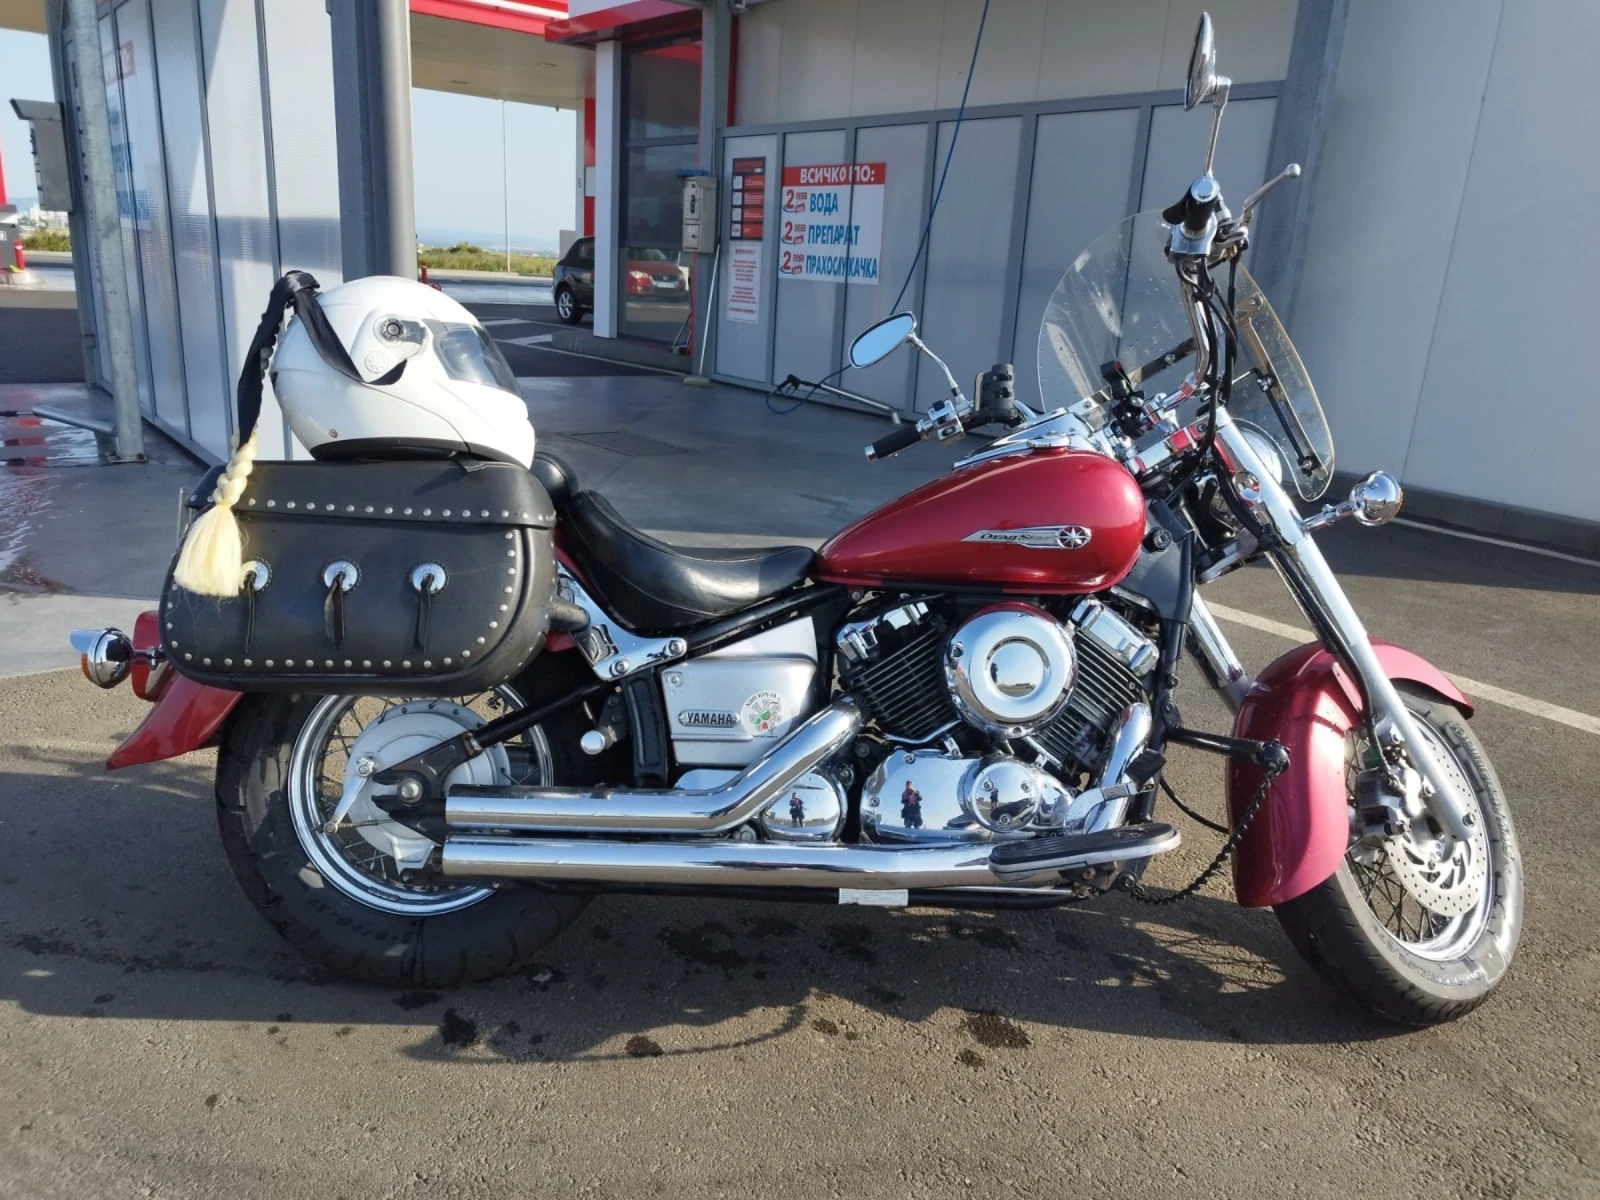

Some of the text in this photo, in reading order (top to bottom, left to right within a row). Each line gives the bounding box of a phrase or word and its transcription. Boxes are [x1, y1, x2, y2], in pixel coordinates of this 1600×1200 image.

[800, 165, 875, 184] ВСИЧКО ПО:
[786, 189, 794, 209] 2
[809, 192, 838, 216] ВОДА
[784, 221, 793, 241] 2
[807, 225, 860, 246] ПРЕПАРАТ
[782, 251, 791, 270] 2
[687, 712, 733, 725] YAMAHA
